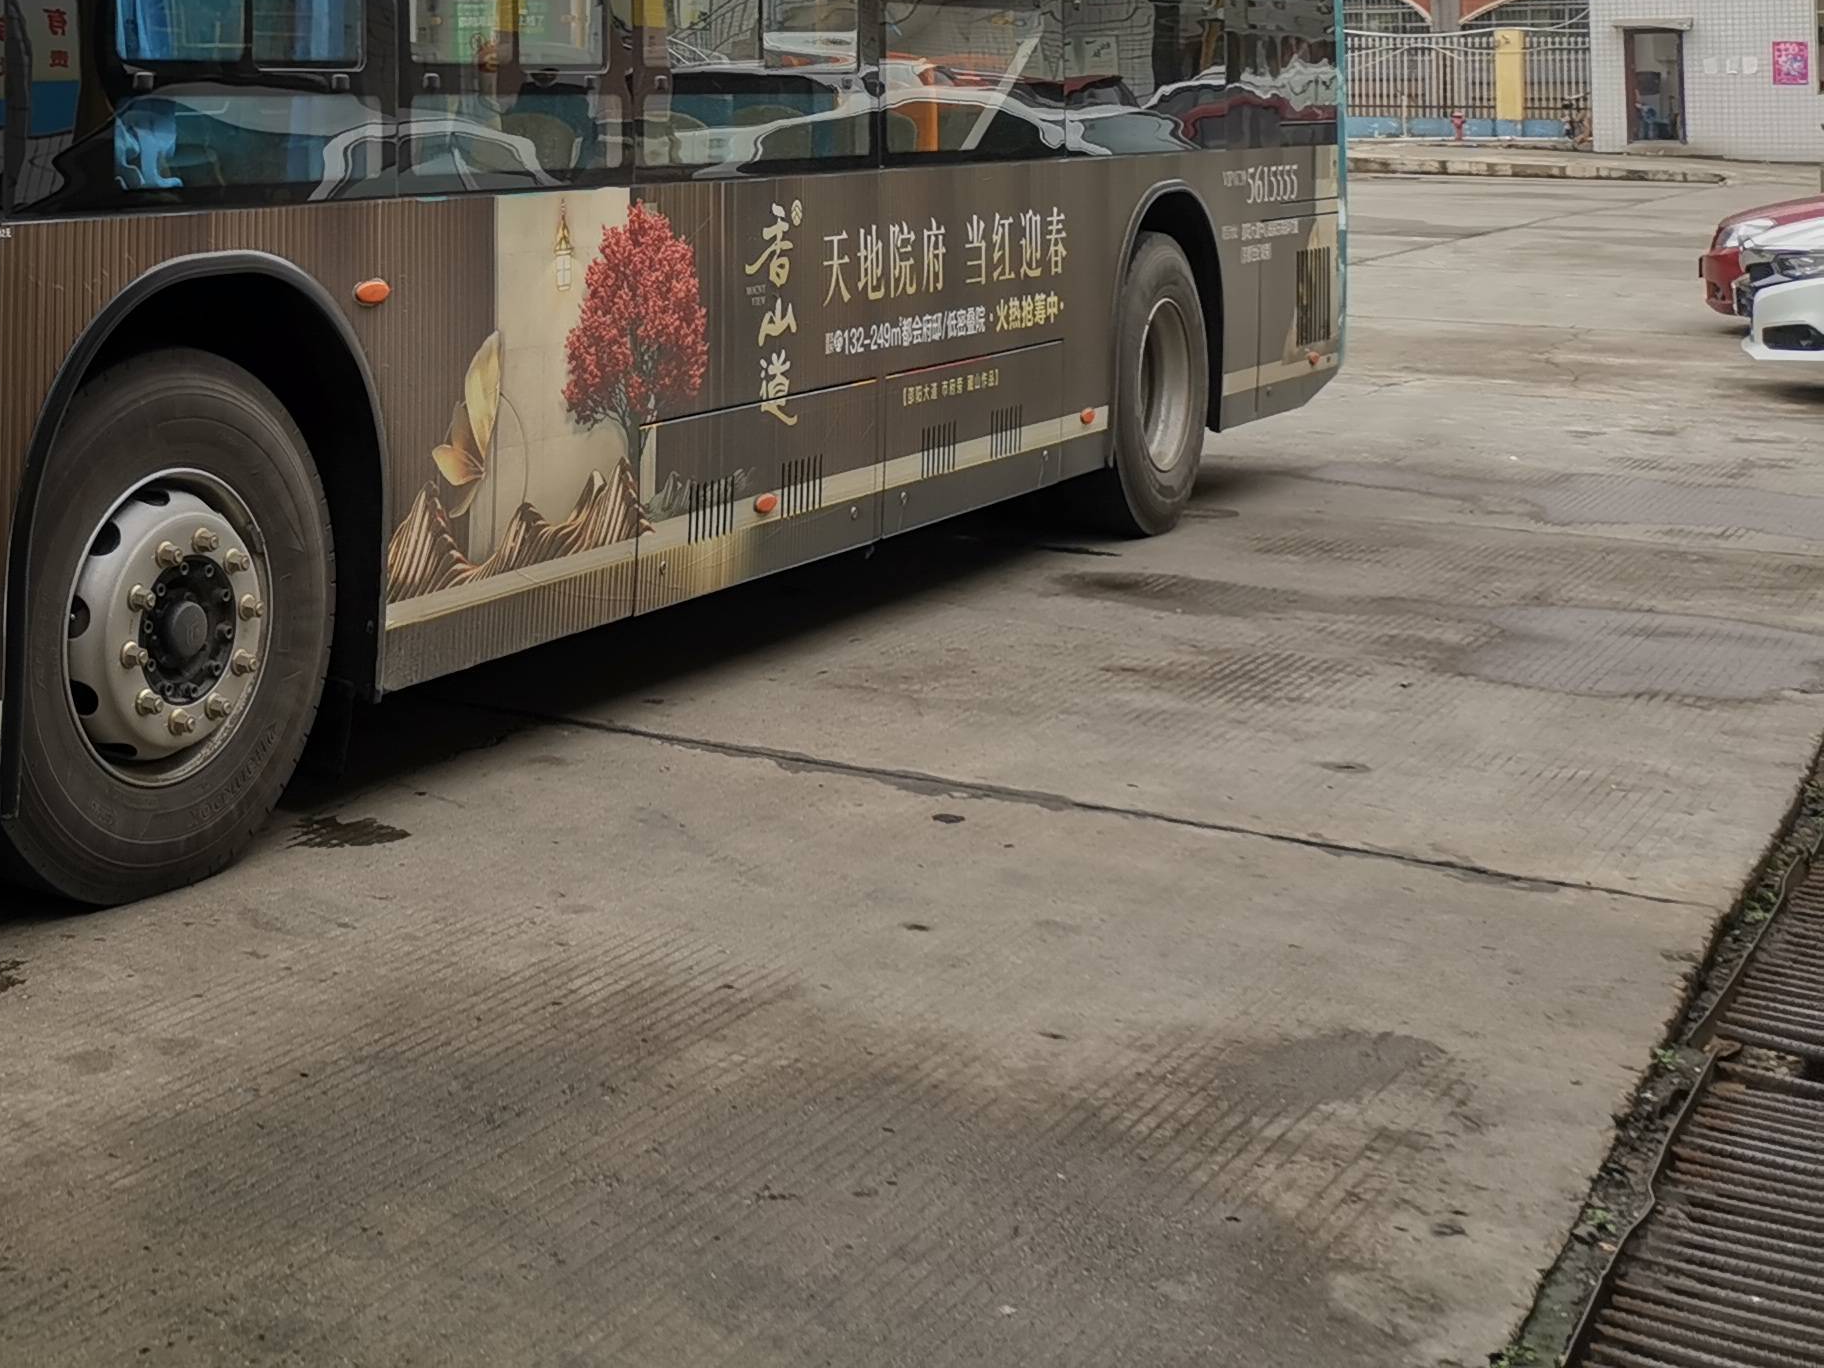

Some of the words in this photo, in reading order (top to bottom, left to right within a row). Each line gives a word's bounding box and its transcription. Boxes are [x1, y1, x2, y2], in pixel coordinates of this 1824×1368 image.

[1246, 165, 1298, 204] 5615555
[823, 217, 947, 307] 天地院府
[965, 206, 1068, 286] 当红迎春
